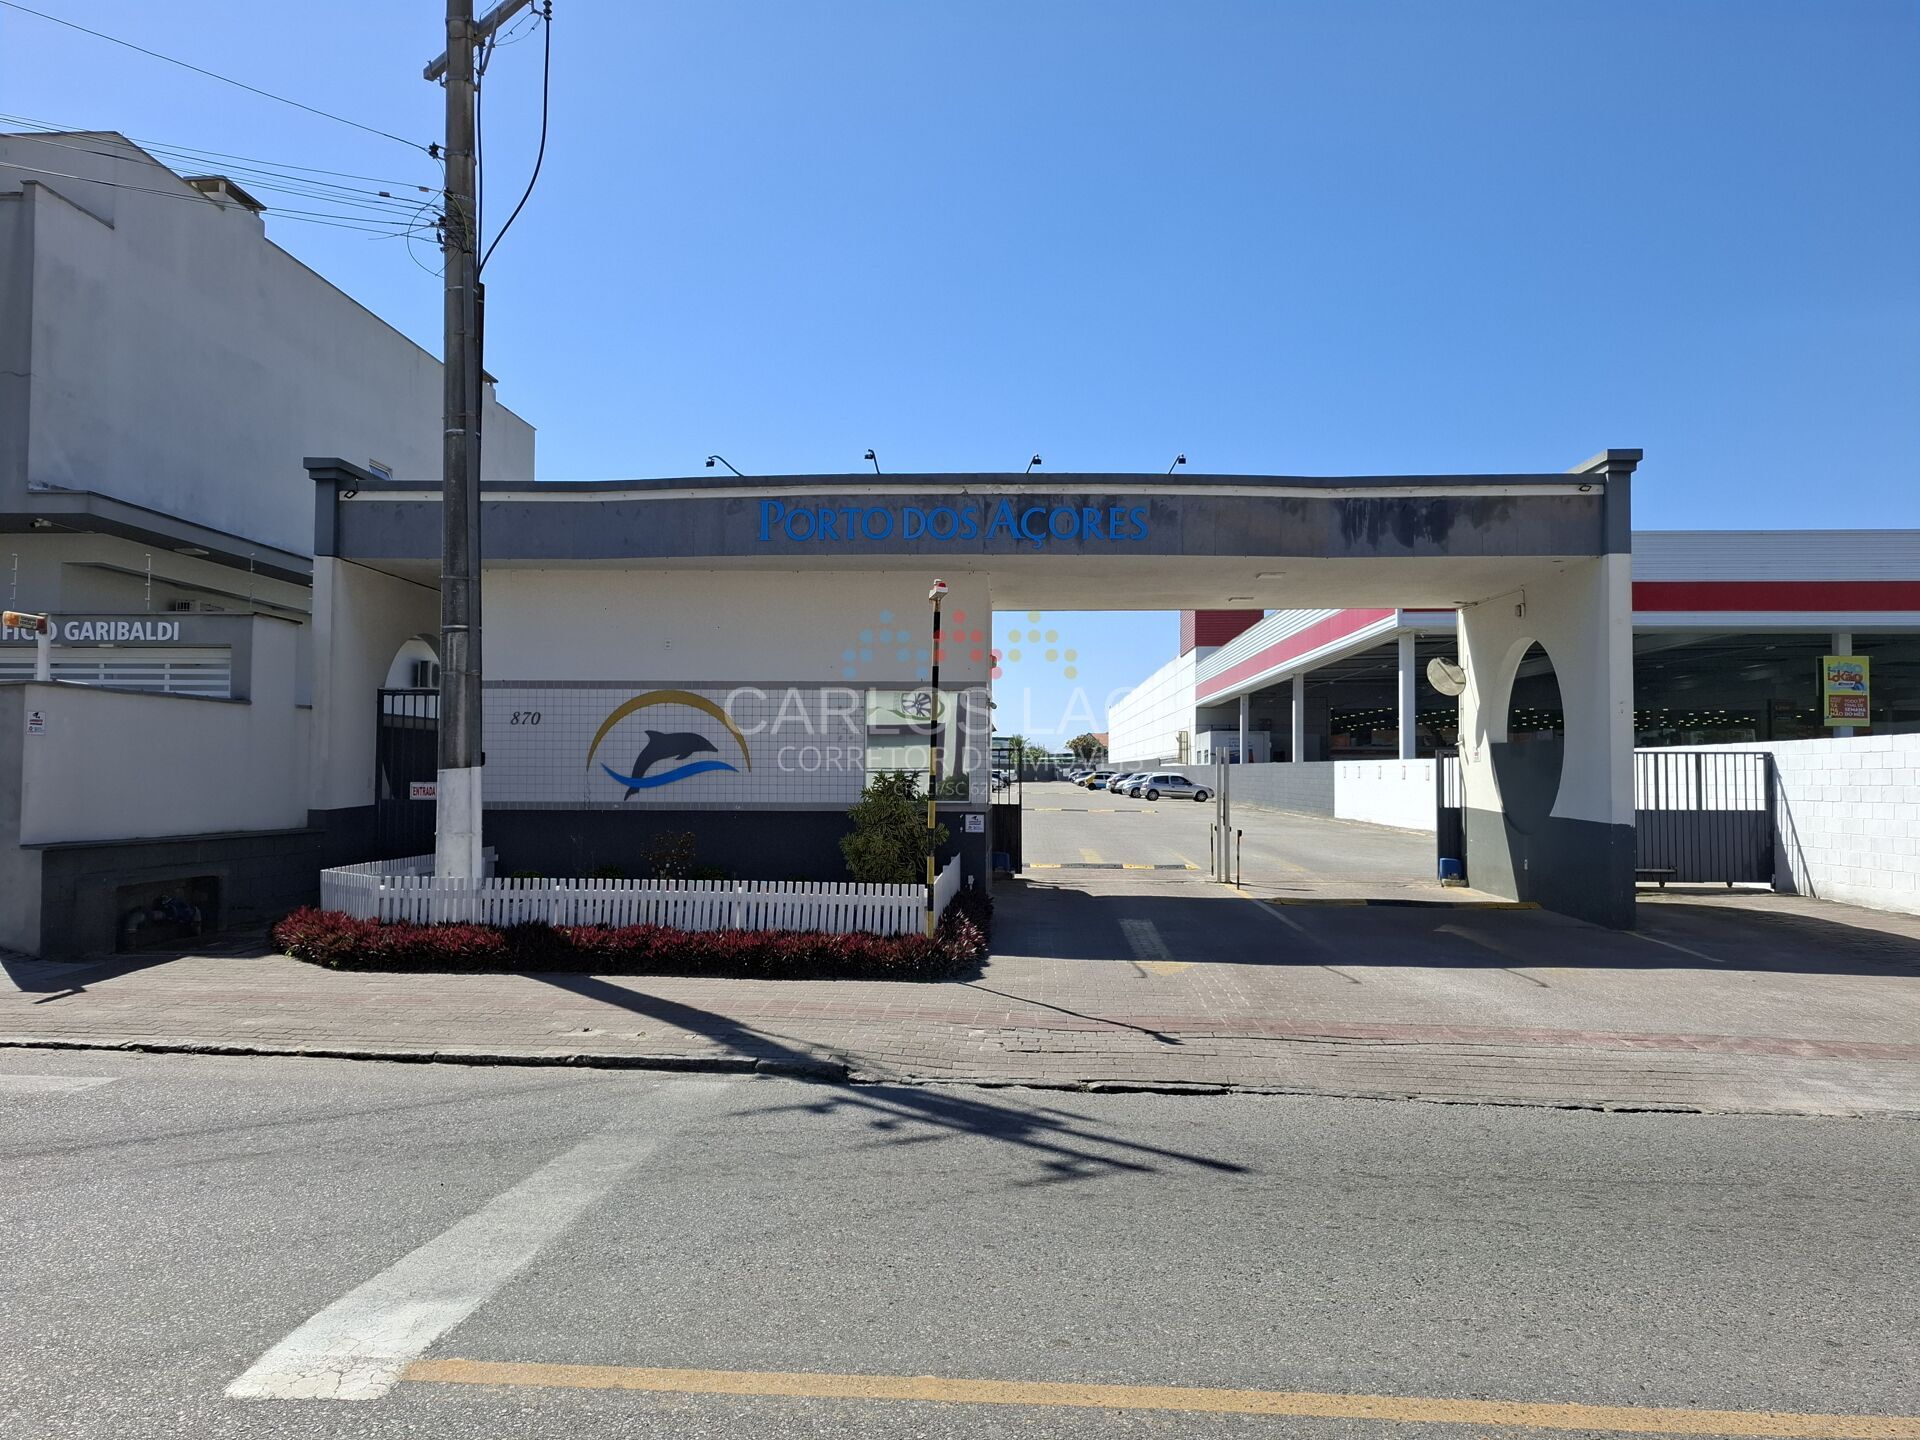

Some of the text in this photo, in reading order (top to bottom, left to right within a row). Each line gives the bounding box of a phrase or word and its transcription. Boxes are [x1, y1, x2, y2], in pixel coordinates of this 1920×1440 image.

[757, 499, 1149, 549] PORTO DOS AÇORES
[64, 621, 179, 641] GARIBALDI
[510, 711, 541, 725] 870
[412, 786, 436, 796] ENTRADA
